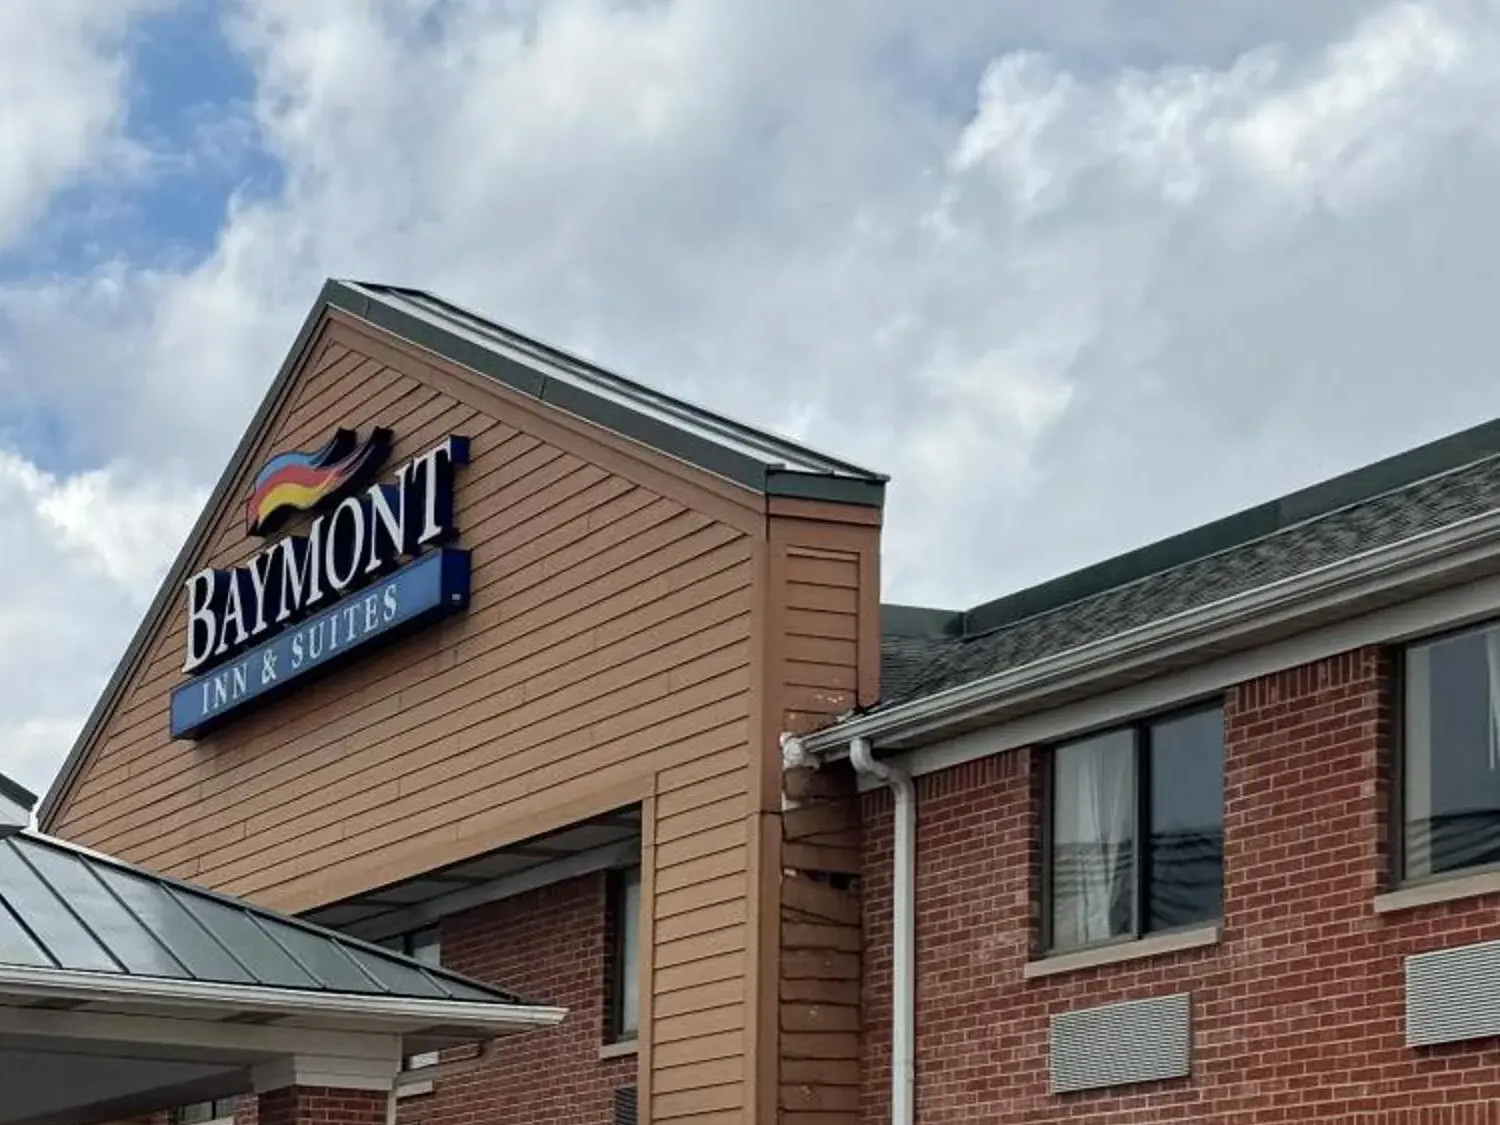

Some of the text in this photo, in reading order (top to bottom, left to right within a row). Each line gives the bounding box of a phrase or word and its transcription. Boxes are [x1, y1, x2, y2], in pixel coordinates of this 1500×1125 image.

[182, 436, 452, 674] BAYMONT
[201, 583, 397, 714] INN & SUITES
